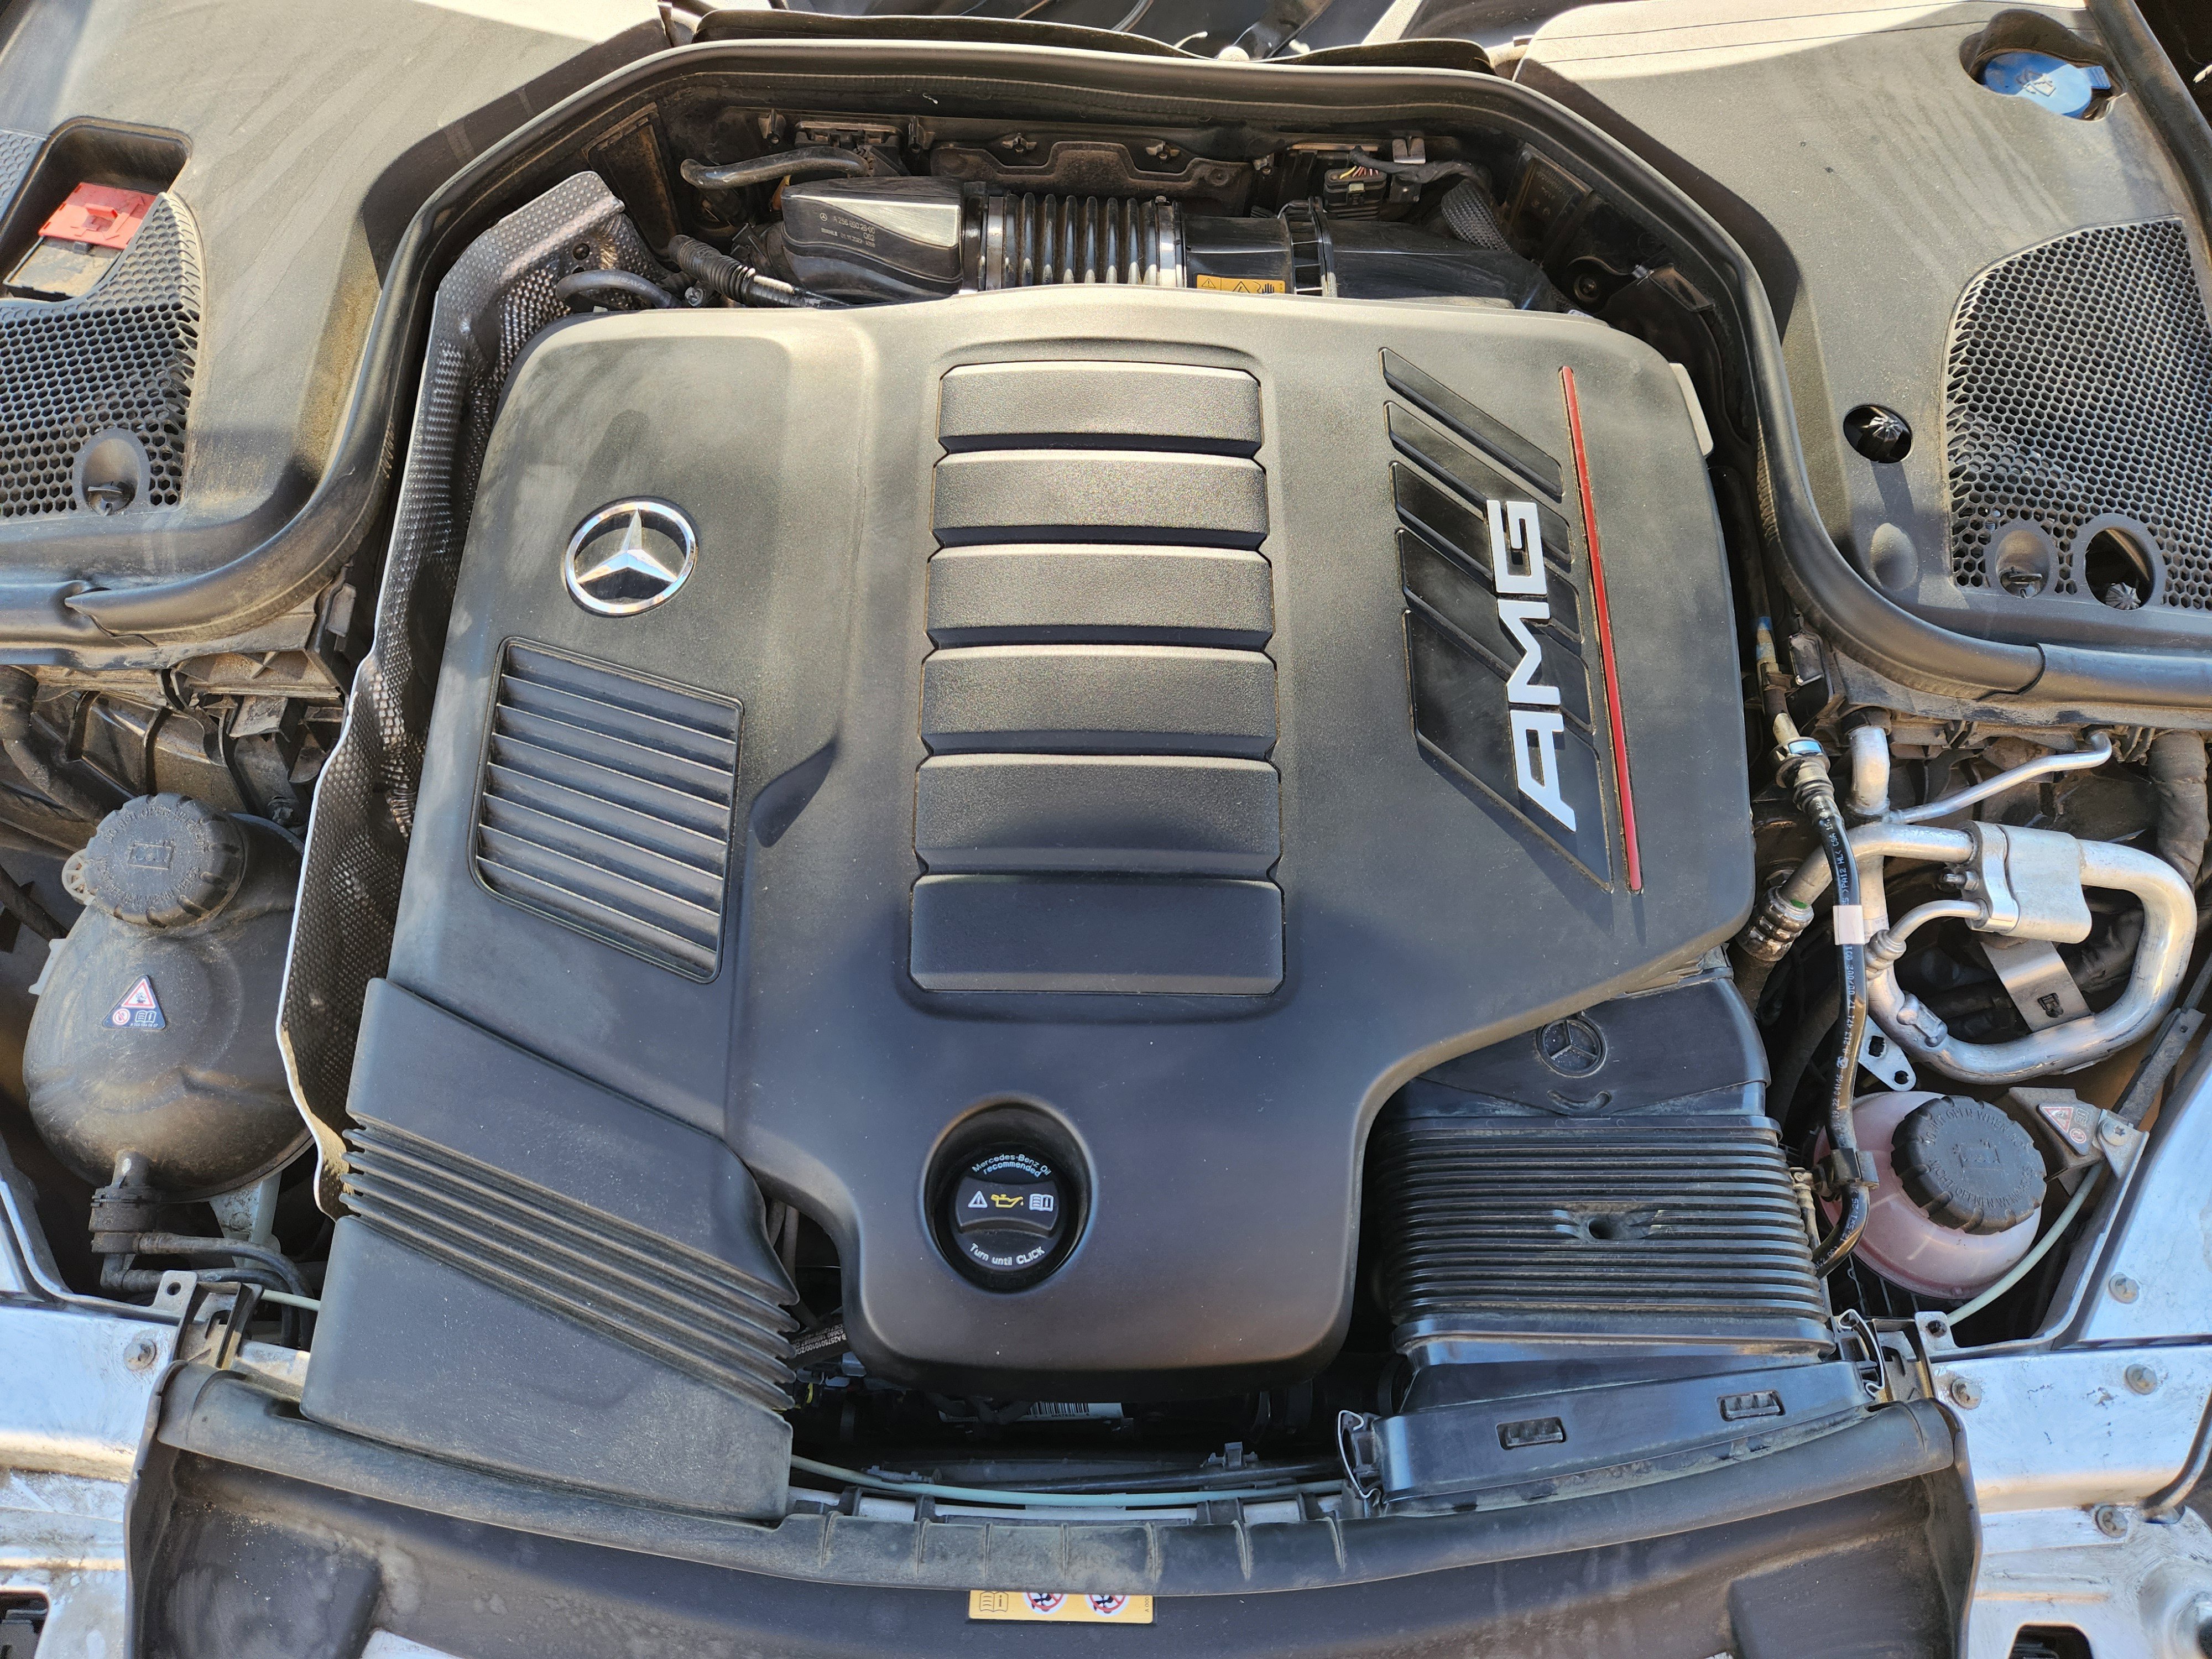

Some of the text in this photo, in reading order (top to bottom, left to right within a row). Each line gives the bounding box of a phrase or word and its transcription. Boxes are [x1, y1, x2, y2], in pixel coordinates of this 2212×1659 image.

[1486, 499, 1576, 832] AMG
[1946, 1108, 1974, 1120] OPEN
[1977, 1110, 2010, 1133] WHEN
[971, 1154, 1052, 1176] Mercedes-Benz Oil
[983, 1161, 1042, 1178] recommended
[970, 1243, 1046, 1266] Turn until CLICK
